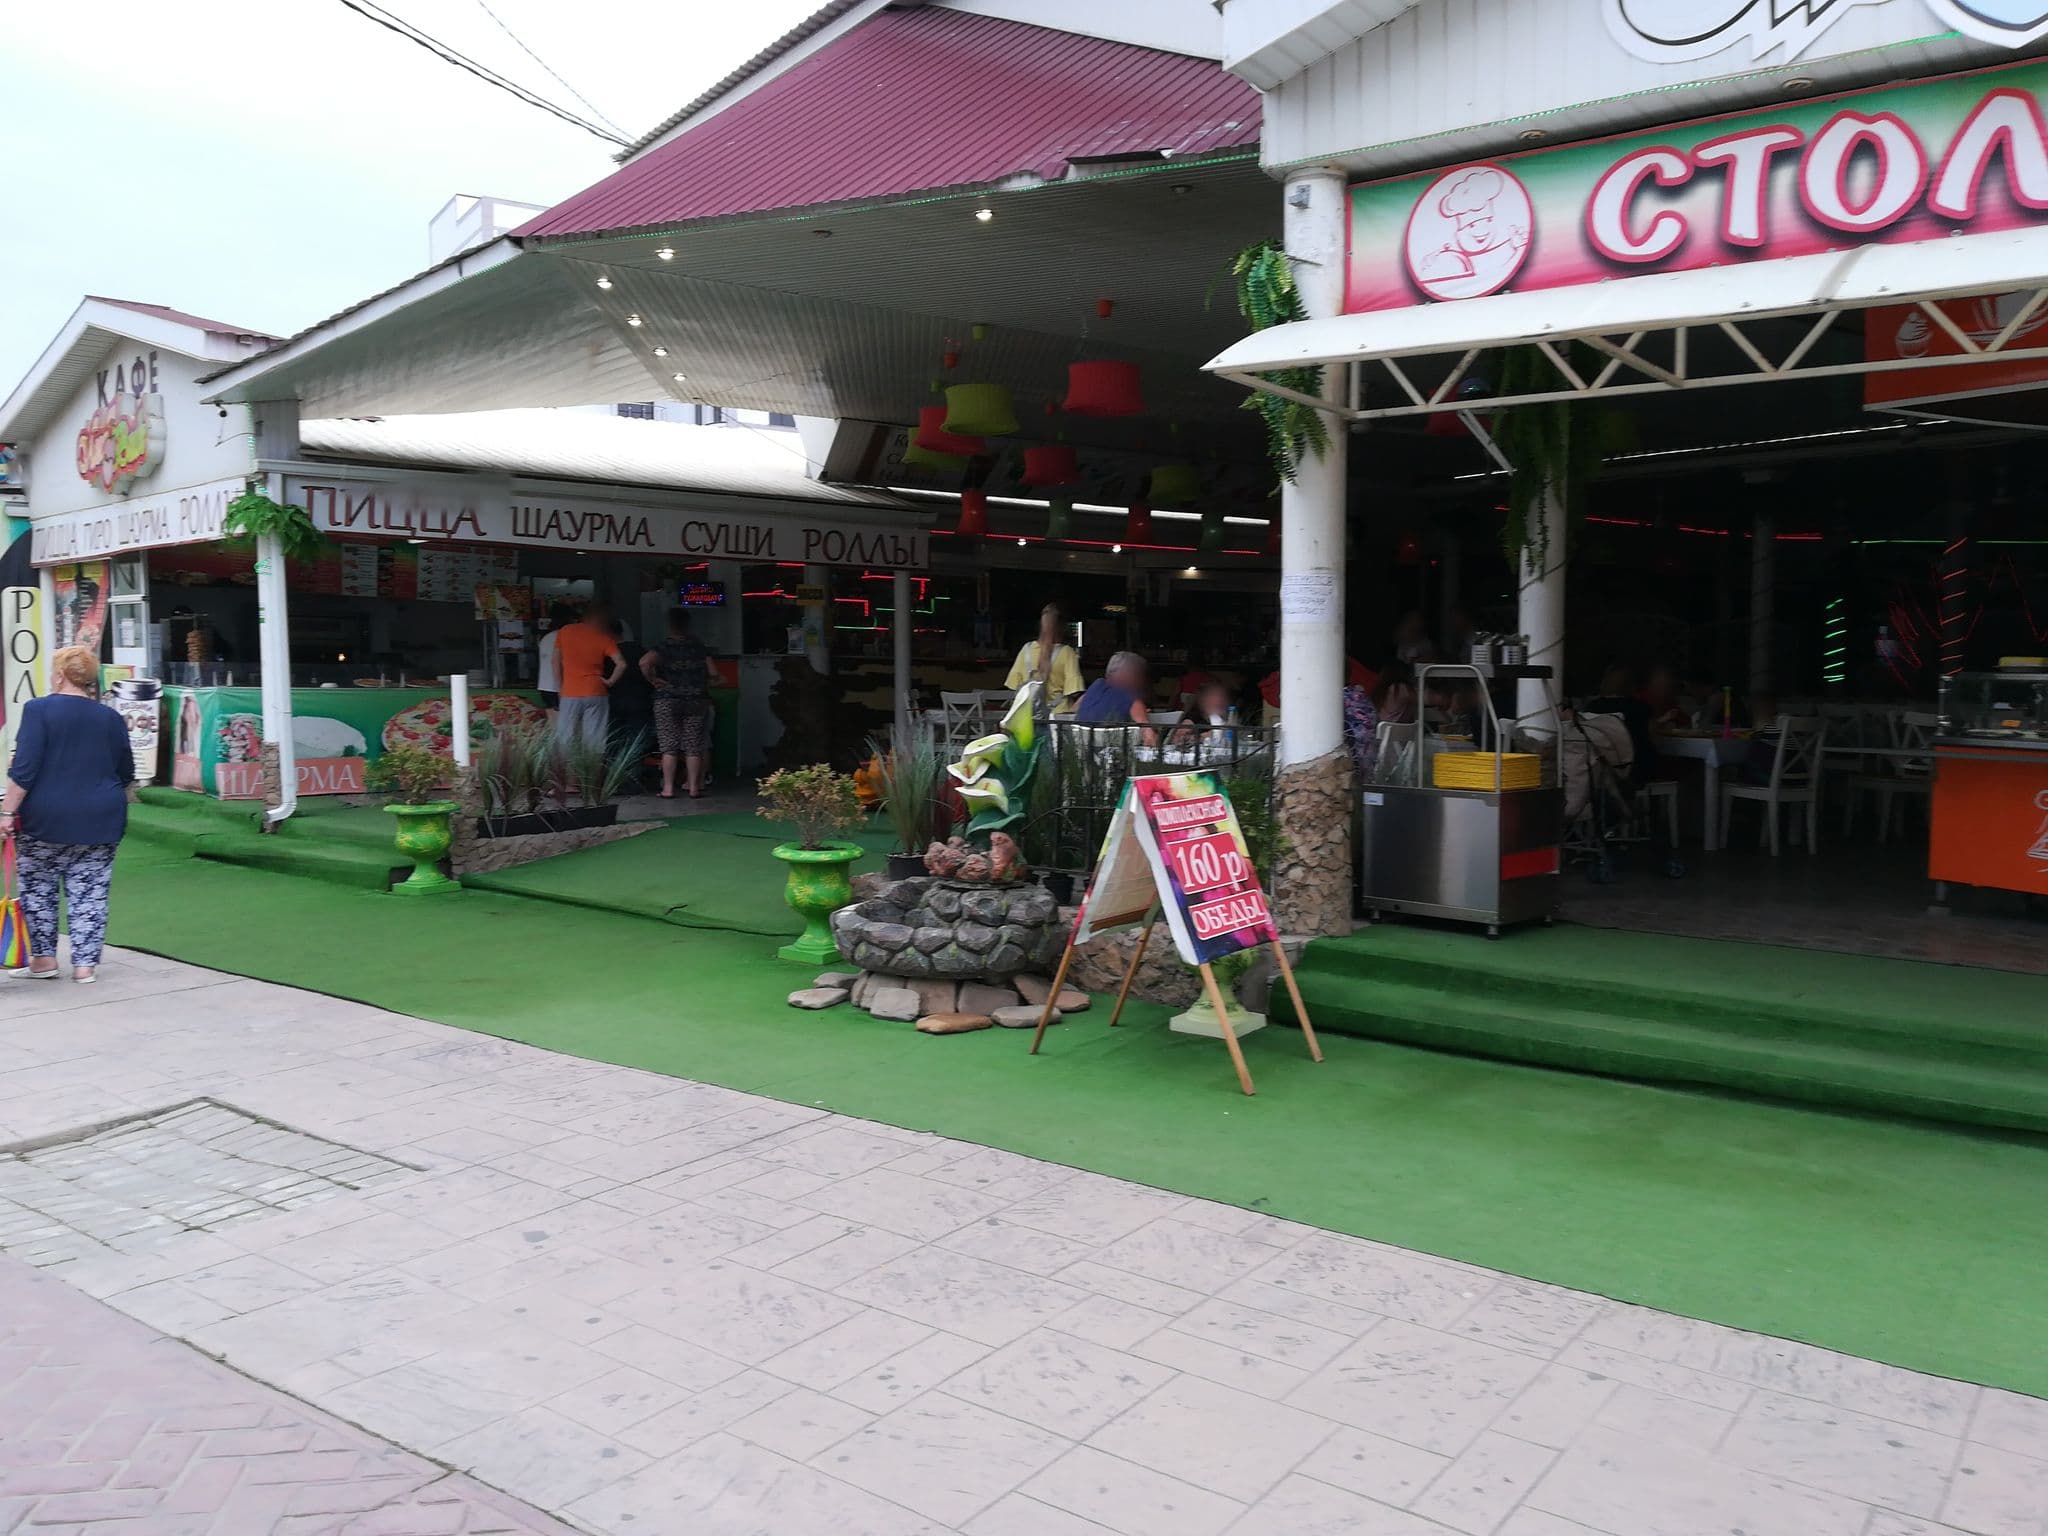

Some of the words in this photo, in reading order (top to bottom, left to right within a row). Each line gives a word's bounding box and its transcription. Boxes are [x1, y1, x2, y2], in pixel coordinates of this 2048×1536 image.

[1587, 88, 2048, 263] СТОЛ
[97, 350, 158, 408] КАФЕ
[118, 506, 170, 545] ШАУРМА
[300, 484, 487, 539] ПИЦЦА
[510, 505, 656, 548] ШАУРМА
[681, 520, 776, 557] СУШИ
[802, 528, 920, 567] РОЛЛЫ
[125, 714, 157, 733] ОФЕ
[216, 764, 359, 796] ШАРМА
[1176, 841, 1222, 888] 160
[1220, 850, 1243, 891] р
[1192, 895, 1265, 934] ОБЕДЫ
